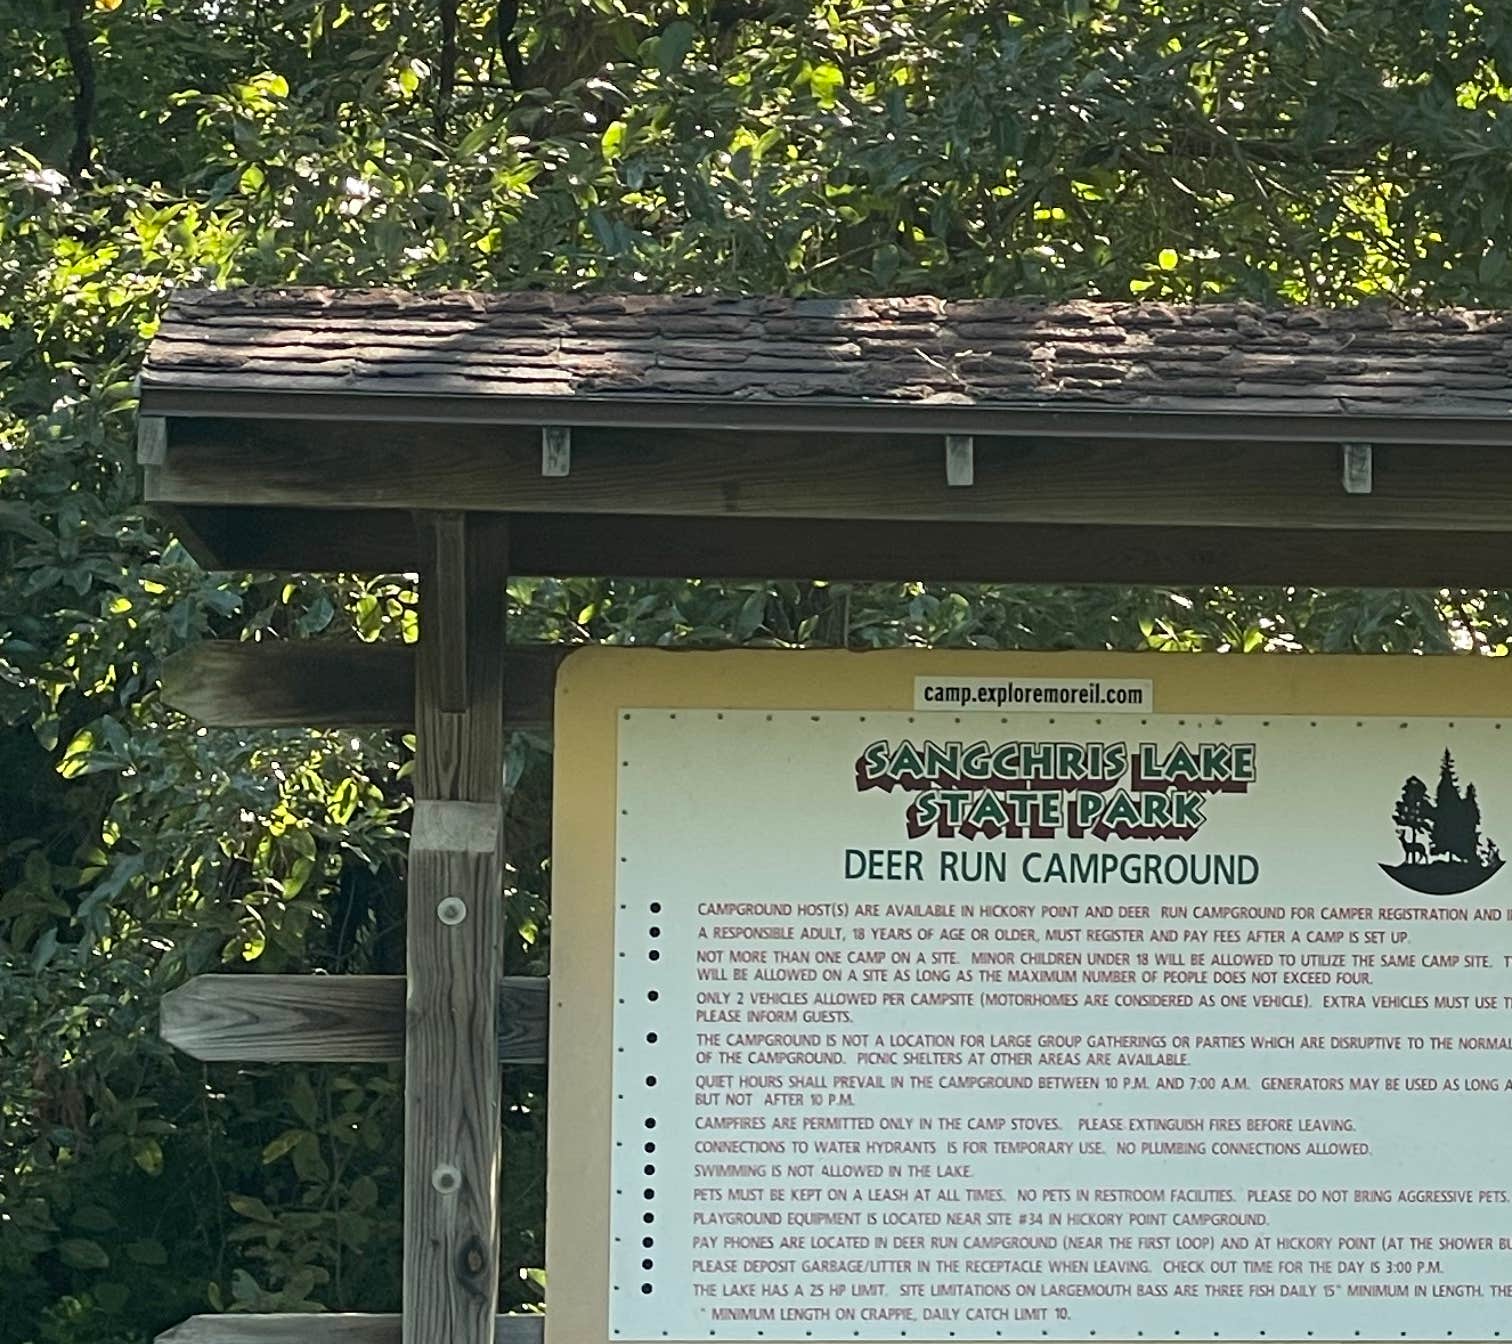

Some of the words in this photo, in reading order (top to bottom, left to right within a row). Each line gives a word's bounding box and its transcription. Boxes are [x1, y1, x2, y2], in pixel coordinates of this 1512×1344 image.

[923, 683, 1143, 707] camp.exploremoreil.com
[856, 740, 1128, 790] SANGCHRIS
[1132, 742, 1257, 792] LAKE
[907, 789, 1065, 839] STATE
[1069, 789, 1208, 839] PARK
[845, 849, 924, 881] DEER
[941, 852, 1007, 882] RUN
[1022, 853, 1260, 885] CAMPGROUND
[698, 903, 792, 916] CAMPGROUND
[797, 902, 849, 917] HOST(S)
[855, 903, 880, 916] ARE
[886, 904, 956, 917] AVAILABLE
[961, 905, 974, 917] IN
[980, 904, 1035, 917] HICKORY
[1041, 906, 1079, 918] POINT
[1085, 906, 1113, 918] AND
[1118, 906, 1150, 918] DEER
[1161, 906, 1187, 919] RUN
[1193, 907, 1285, 920] CAMPGROUND
[1291, 907, 1315, 920] FOR
[1321, 907, 1373, 920] CAMPER
[1378, 908, 1468, 921] REGISTRATION
[1474, 909, 1502, 921] AND
[696, 991, 731, 1004] ONLY
[737, 992, 744, 1005] 2
[750, 992, 808, 1005] VEHICLES
[813, 992, 877, 1005] ALLOWED
[883, 992, 905, 1005] PER
[911, 993, 974, 1006] CAMPSITE
[980, 992, 1078, 1008] (MOTORHOMES
[1084, 994, 1109, 1007] ARE
[1115, 994, 1193, 1007] CONSIDERED
[1198, 994, 1215, 1007] AS
[1221, 994, 1247, 1007] ONE
[1323, 995, 1366, 1008] EXTRA
[1372, 995, 1429, 1008] VEHICLES
[1434, 996, 1469, 1009] MUST
[1475, 997, 1498, 1009] USE
[696, 1010, 741, 1023] PLEASE
[747, 1010, 797, 1023] INFORM
[696, 1051, 712, 1064] OF
[718, 1051, 742, 1064] THE
[857, 1052, 898, 1065] PICNIC
[903, 1052, 963, 1065] SHELTERS
[968, 1052, 985, 1064] AT
[990, 1053, 1032, 1066] OTHER
[1038, 1053, 1081, 1066] AREAS
[1086, 1053, 1111, 1066] ARE
[695, 1092, 720, 1105] BUT
[726, 1093, 752, 1106] NOT
[764, 1093, 804, 1106] AFTER
[810, 1094, 823, 1106] 10
[695, 1141, 785, 1153] CONNECTIONS
[792, 1141, 809, 1153] TO
[814, 1141, 860, 1153] WATER
[866, 1141, 936, 1154] HYDRANTS
[947, 1141, 958, 1154] IS
[963, 1141, 988, 1154] FOR
[993, 1141, 1073, 1154] TEMPORARY
[1117, 1142, 1136, 1155] NO
[1141, 1142, 1206, 1155] PLUMBING
[1212, 1142, 1301, 1155] CONNECTIONS
[694, 1164, 766, 1177] SWIMMING
[772, 1165, 782, 1177] IS
[787, 1164, 814, 1177] NOT
[821, 1164, 883, 1177] ALLOWED
[889, 1165, 901, 1177] IN
[908, 1165, 931, 1178] THE
[693, 1212, 782, 1226] PLAYGROUND
[788, 1212, 862, 1227] EQUIPMENT
[867, 1212, 877, 1225] IS
[883, 1212, 941, 1225] LOCATED
[946, 1212, 981, 1225] NEAR
[986, 1212, 1012, 1225] SITE
[1019, 1212, 1043, 1225] #34
[1049, 1213, 1062, 1226] IN
[1067, 1213, 1123, 1226] HICKORY
[1129, 1213, 1167, 1226] POINT
[712, 1308, 775, 1320] MINIMUM
[780, 1308, 830, 1321] LENGTH
[835, 1308, 855, 1320] ON
[923, 1308, 960, 1320] DAILY
[966, 1307, 1009, 1321] CATCH
[1014, 1307, 1048, 1320] LIMIT
[1054, 1307, 1071, 1320] 10.
